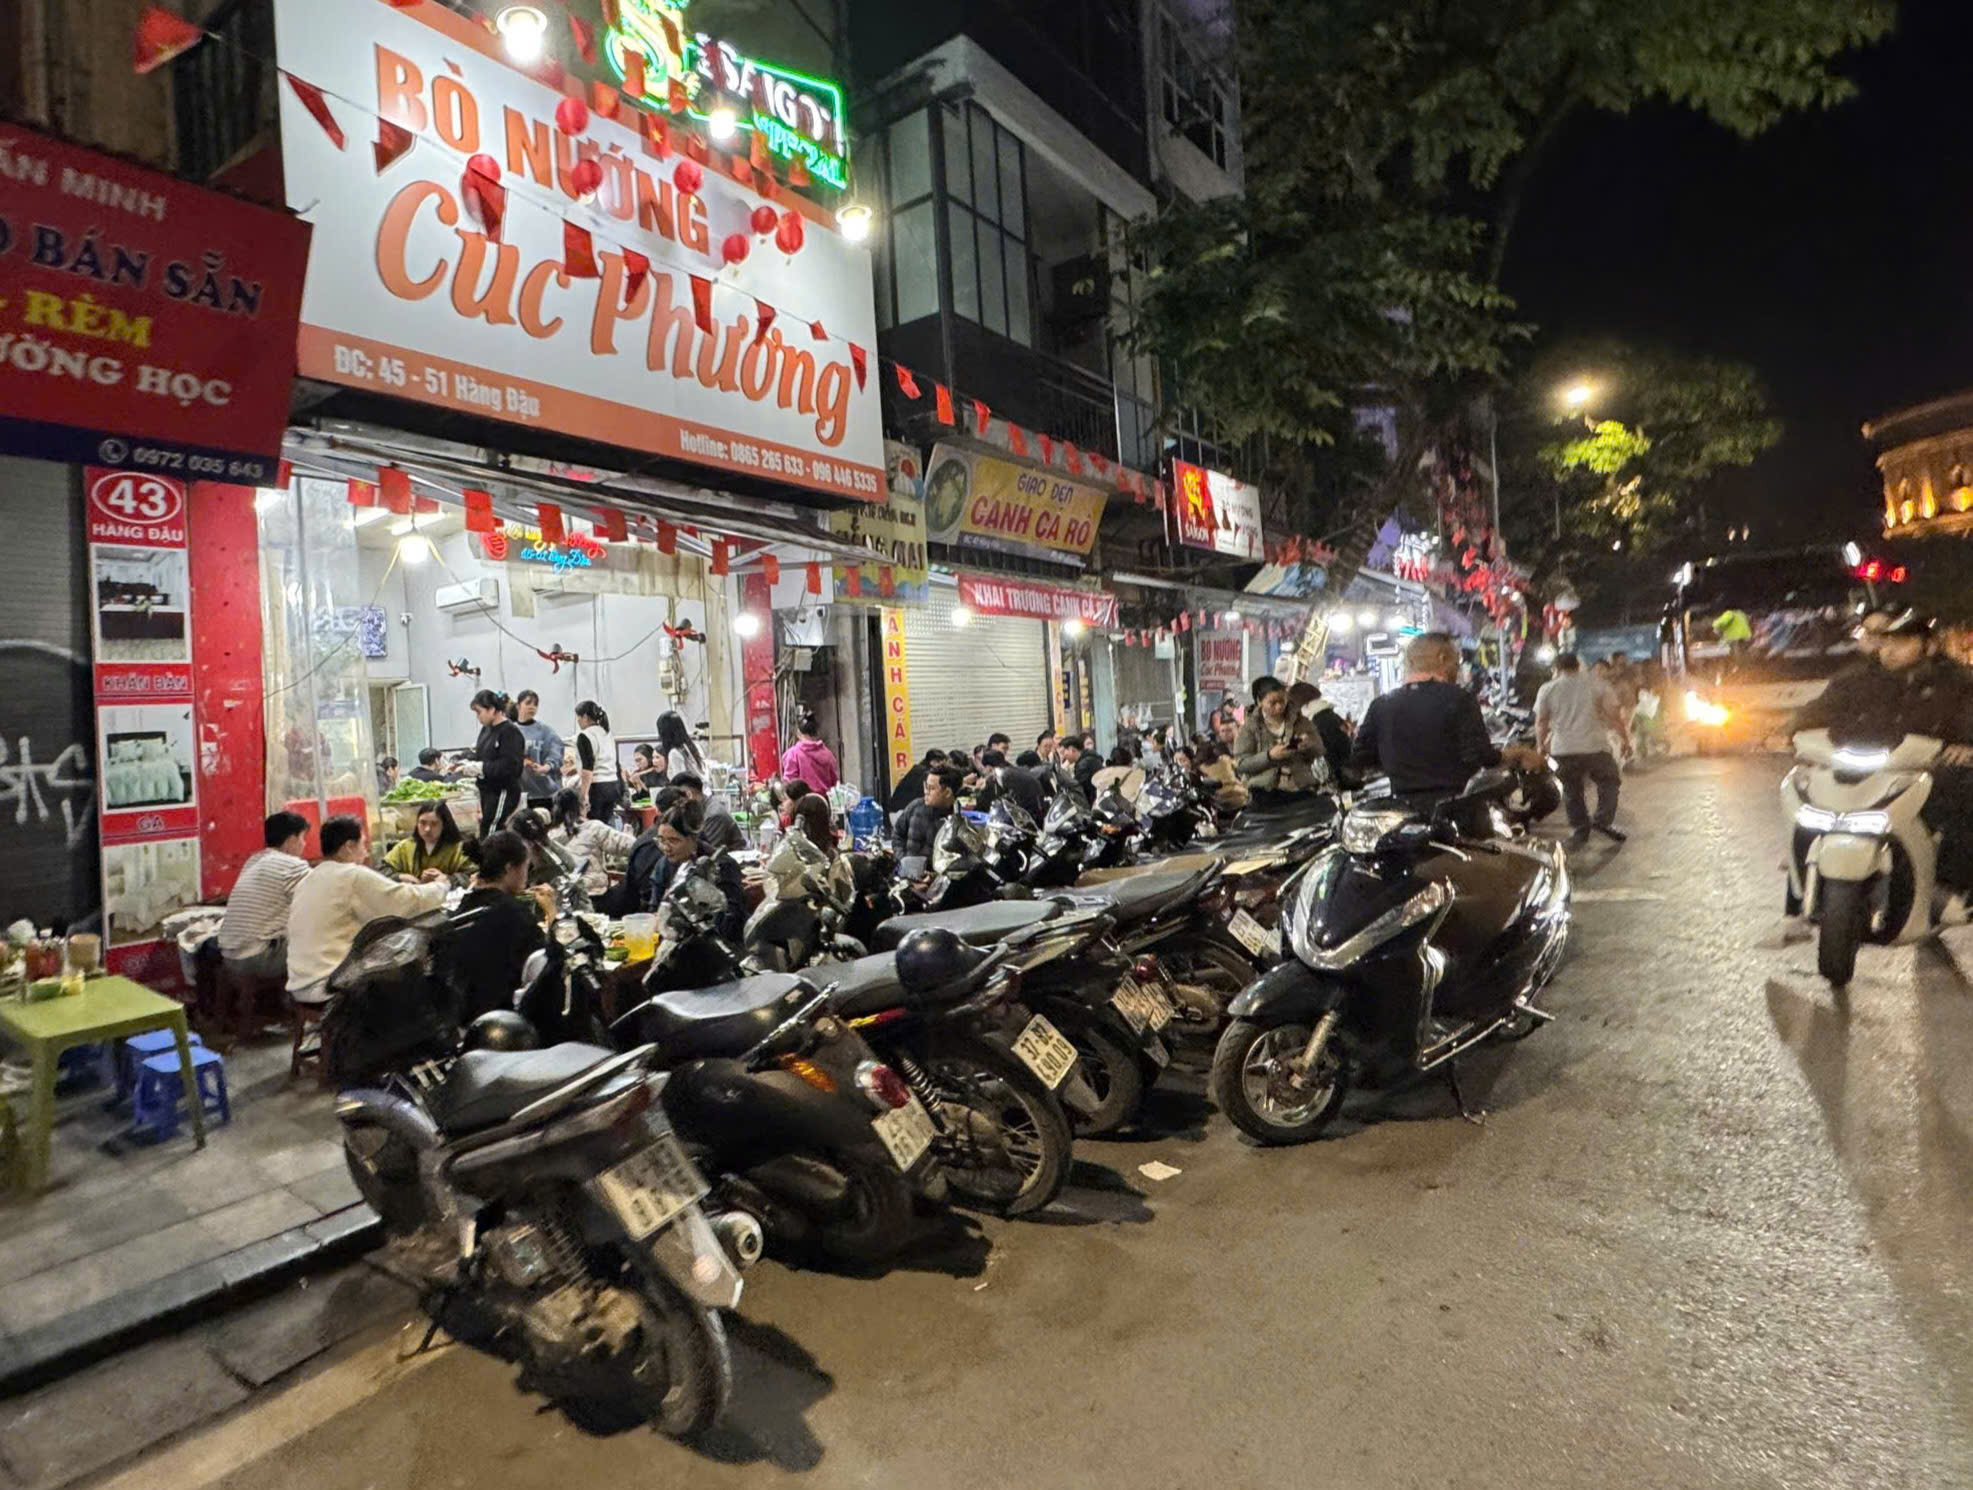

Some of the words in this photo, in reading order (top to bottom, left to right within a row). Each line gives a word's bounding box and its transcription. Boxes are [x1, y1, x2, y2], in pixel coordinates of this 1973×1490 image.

[375, 43, 480, 154] BÒ
[503, 105, 711, 256] NƯỚNG
[61, 168, 167, 221] MINH
[33, 223, 148, 287] BÁN
[136, 364, 233, 407] HỌC
[378, 356, 407, 388] 45
[424, 367, 449, 397] 51
[455, 373, 502, 412] Hàng
[108, 479, 168, 517] 43
[971, 495, 1033, 534] CANH
[92, 522, 144, 540] HÀNG
[148, 526, 184, 543] ĐẬU
[973, 583, 1005, 607] KHAI
